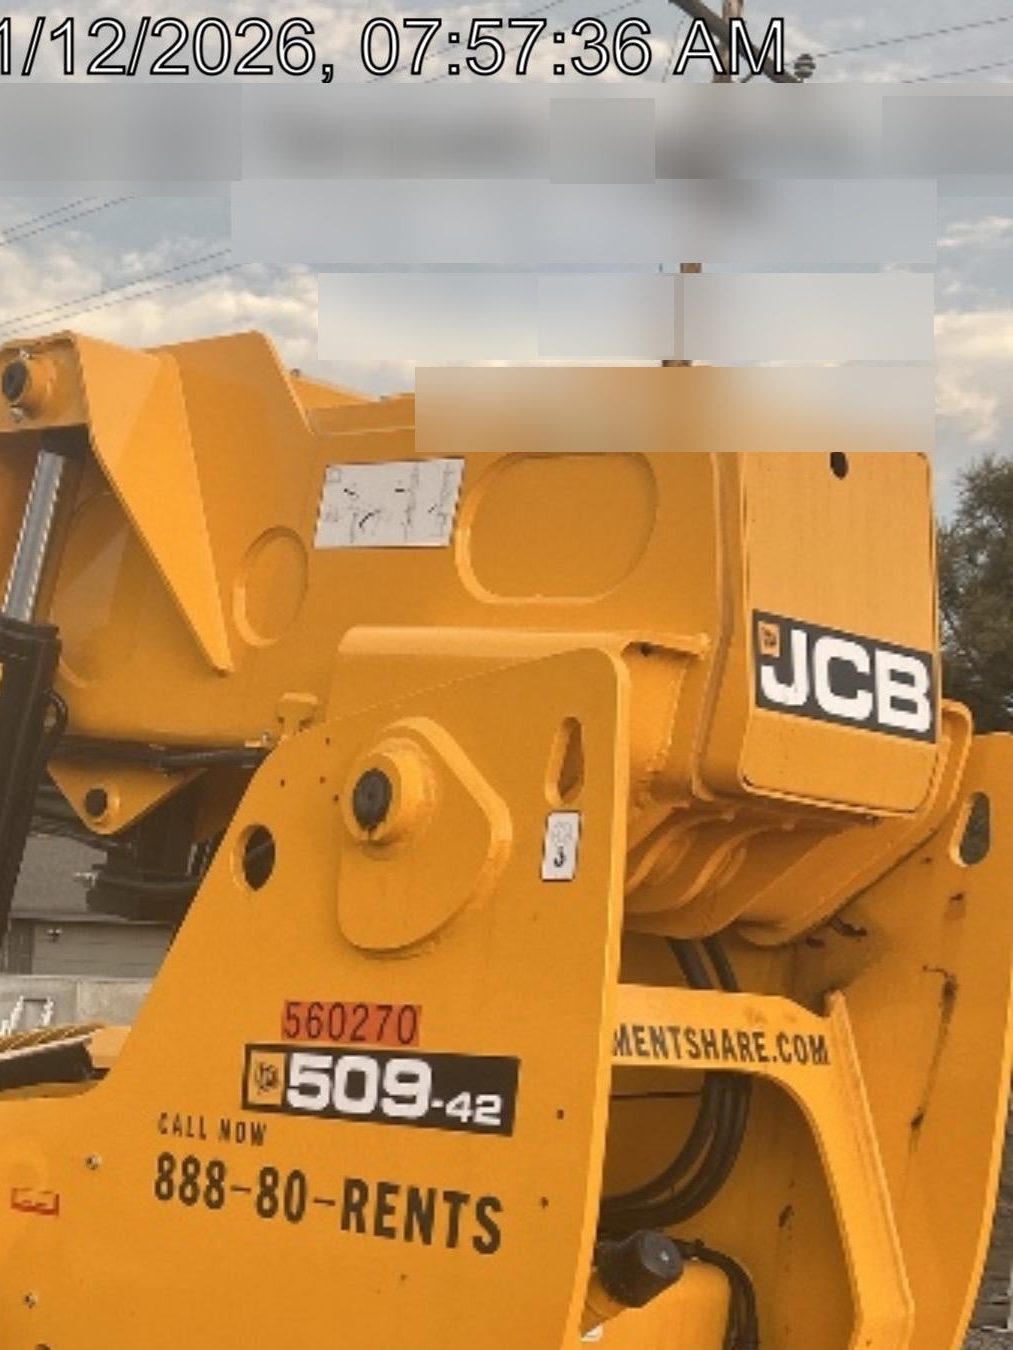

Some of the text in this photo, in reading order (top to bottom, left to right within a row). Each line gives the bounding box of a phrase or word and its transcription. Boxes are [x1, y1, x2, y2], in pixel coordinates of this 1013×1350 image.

[761, 628, 931, 733] JCB
[284, 1002, 418, 1044] 560270
[286, 1053, 501, 1126] 509-42
[158, 1113, 268, 1146] CALL NOW
[154, 1152, 503, 1255] 888-80-RENTS
